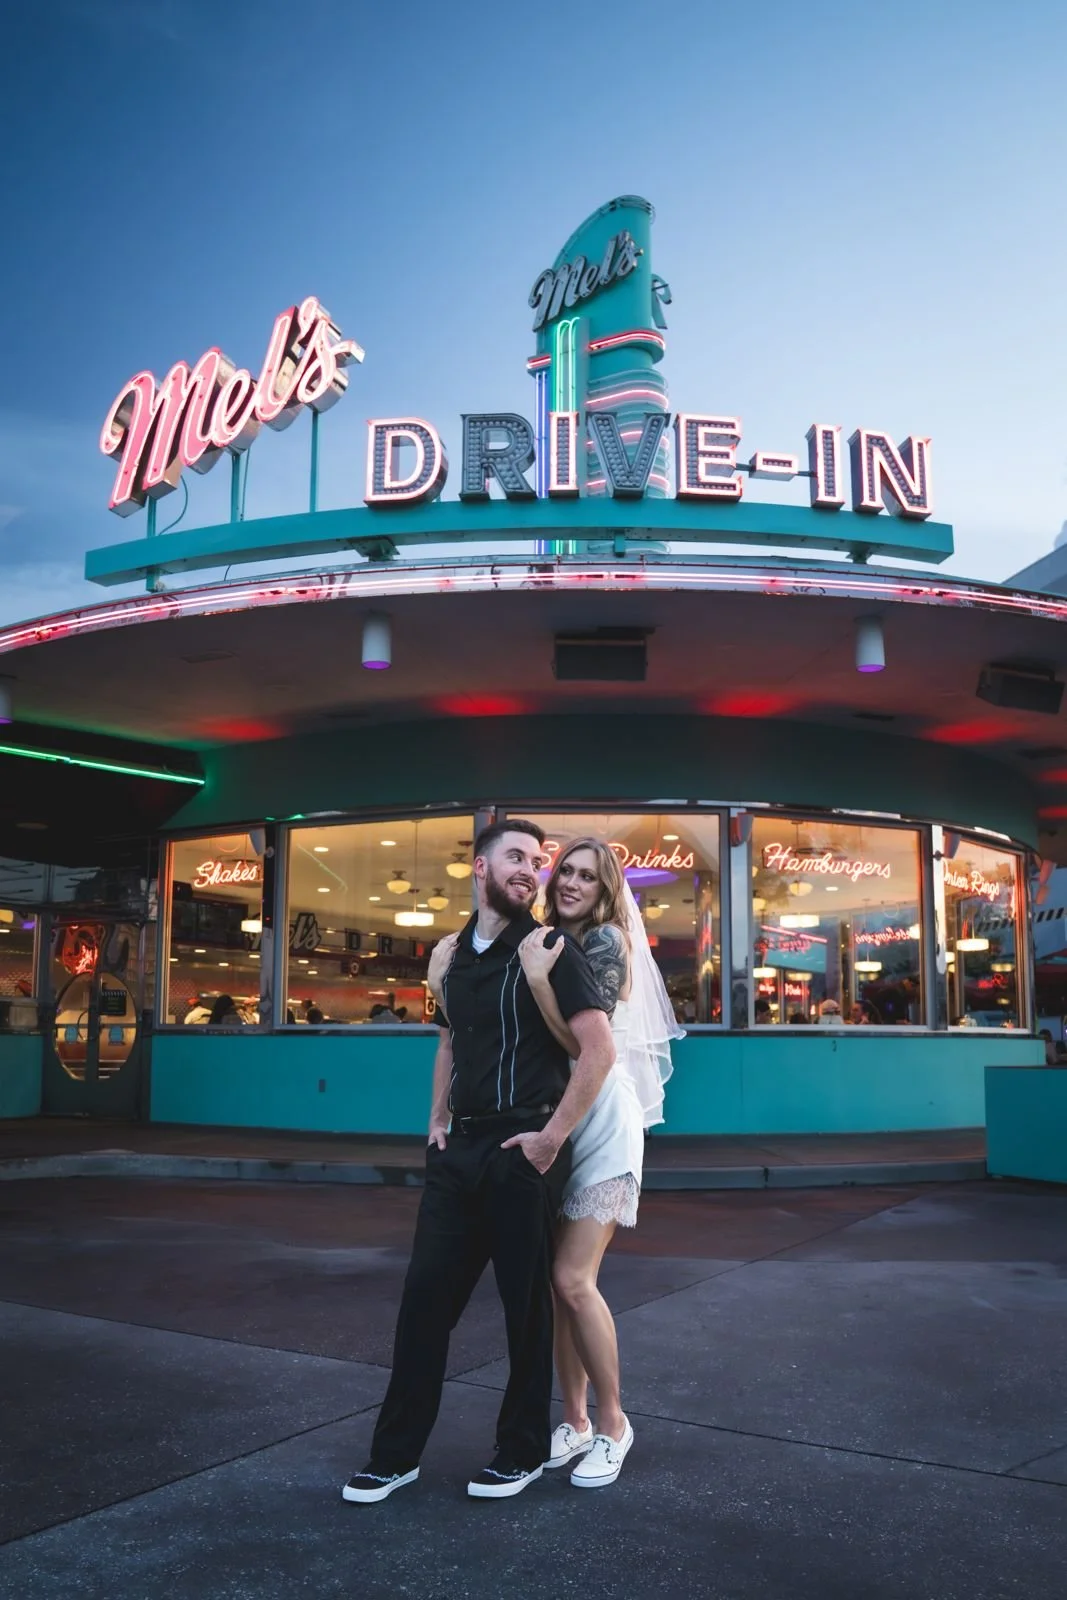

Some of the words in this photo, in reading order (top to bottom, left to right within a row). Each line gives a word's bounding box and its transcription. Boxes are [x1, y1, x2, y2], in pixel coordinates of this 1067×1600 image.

[528, 229, 644, 332] Mel's
[99, 295, 365, 518] Mel's
[363, 411, 933, 521] DRIVE-IN
[607, 843, 694, 869] Drinks
[764, 843, 891, 883] Hamburgers
[194, 861, 258, 888] Shakes
[970, 870, 1000, 902] Rings
